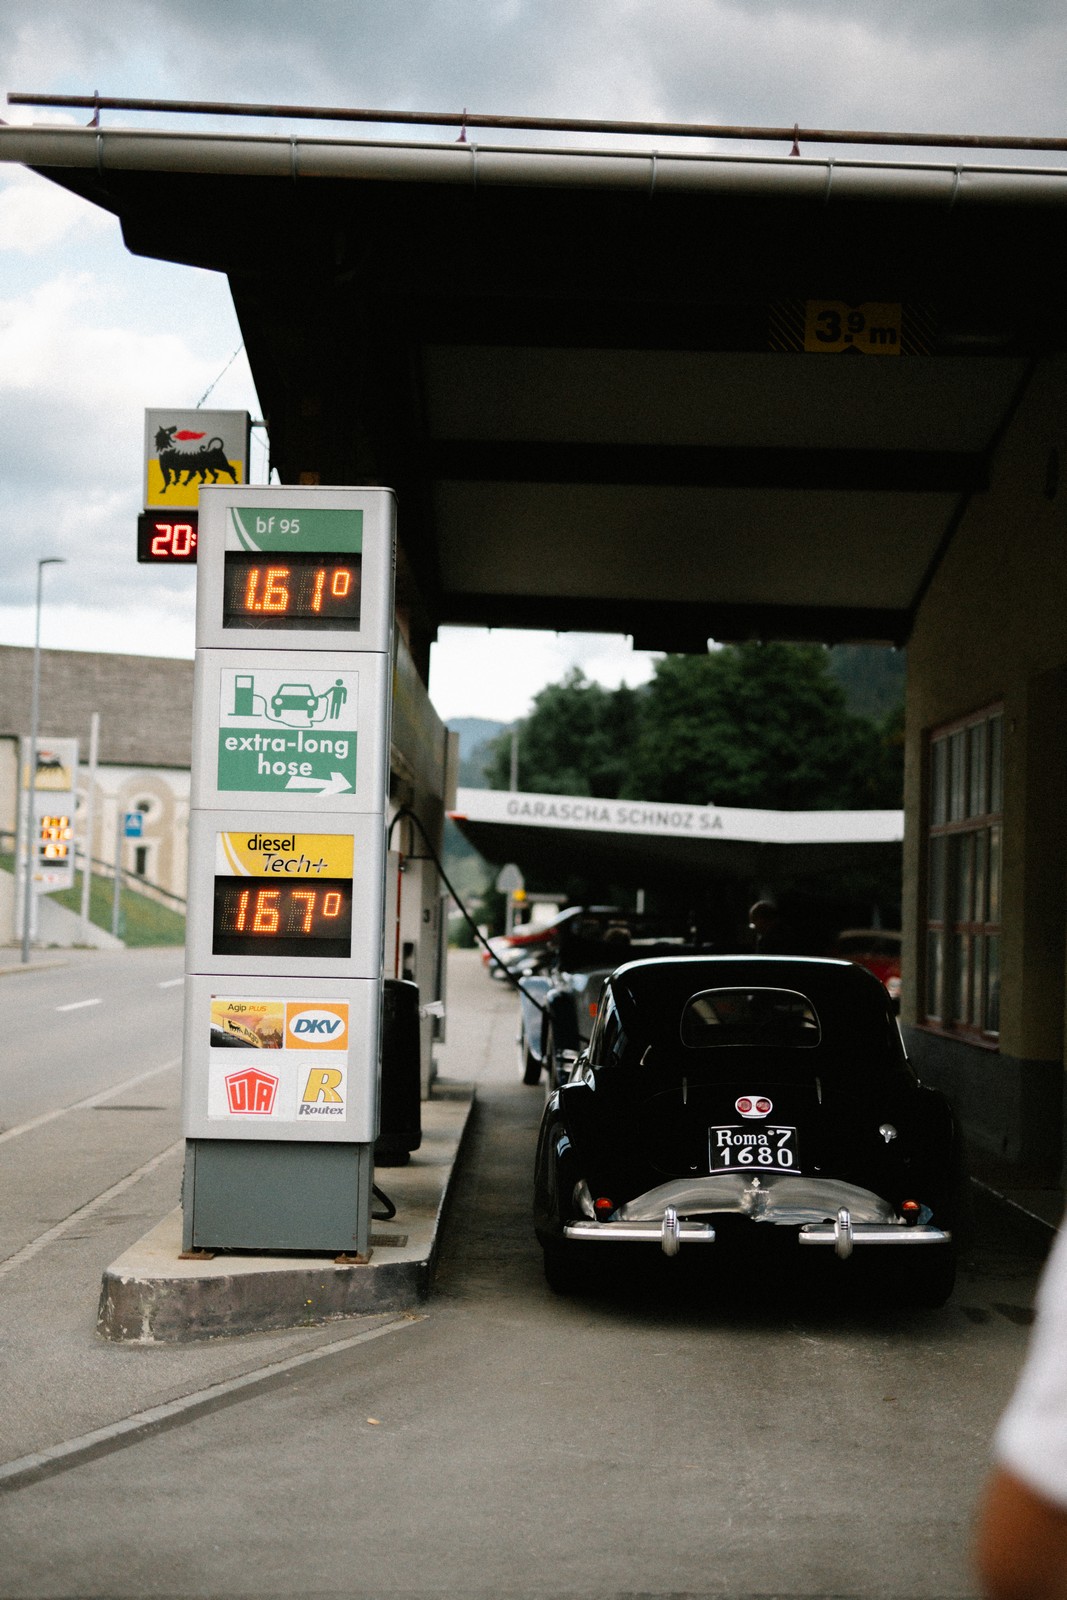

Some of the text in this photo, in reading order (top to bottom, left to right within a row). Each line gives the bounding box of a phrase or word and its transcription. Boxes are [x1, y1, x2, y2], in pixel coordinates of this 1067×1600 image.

[816, 311, 897, 344] 3.9 m
[256, 516, 300, 533] bf 95
[225, 731, 349, 759] extra-long
[258, 753, 313, 776] hose
[507, 800, 723, 830] GARASCHA SCHNOZ SA
[247, 834, 295, 851] diesel
[262, 853, 328, 873] Tech+
[227, 1003, 247, 1012] Agip
[294, 1019, 341, 1034] DKV
[228, 1070, 275, 1112] UTA
[299, 1104, 344, 1115] Routex
[716, 1129, 792, 1147] Roma 7
[720, 1147, 793, 1167] 1680
